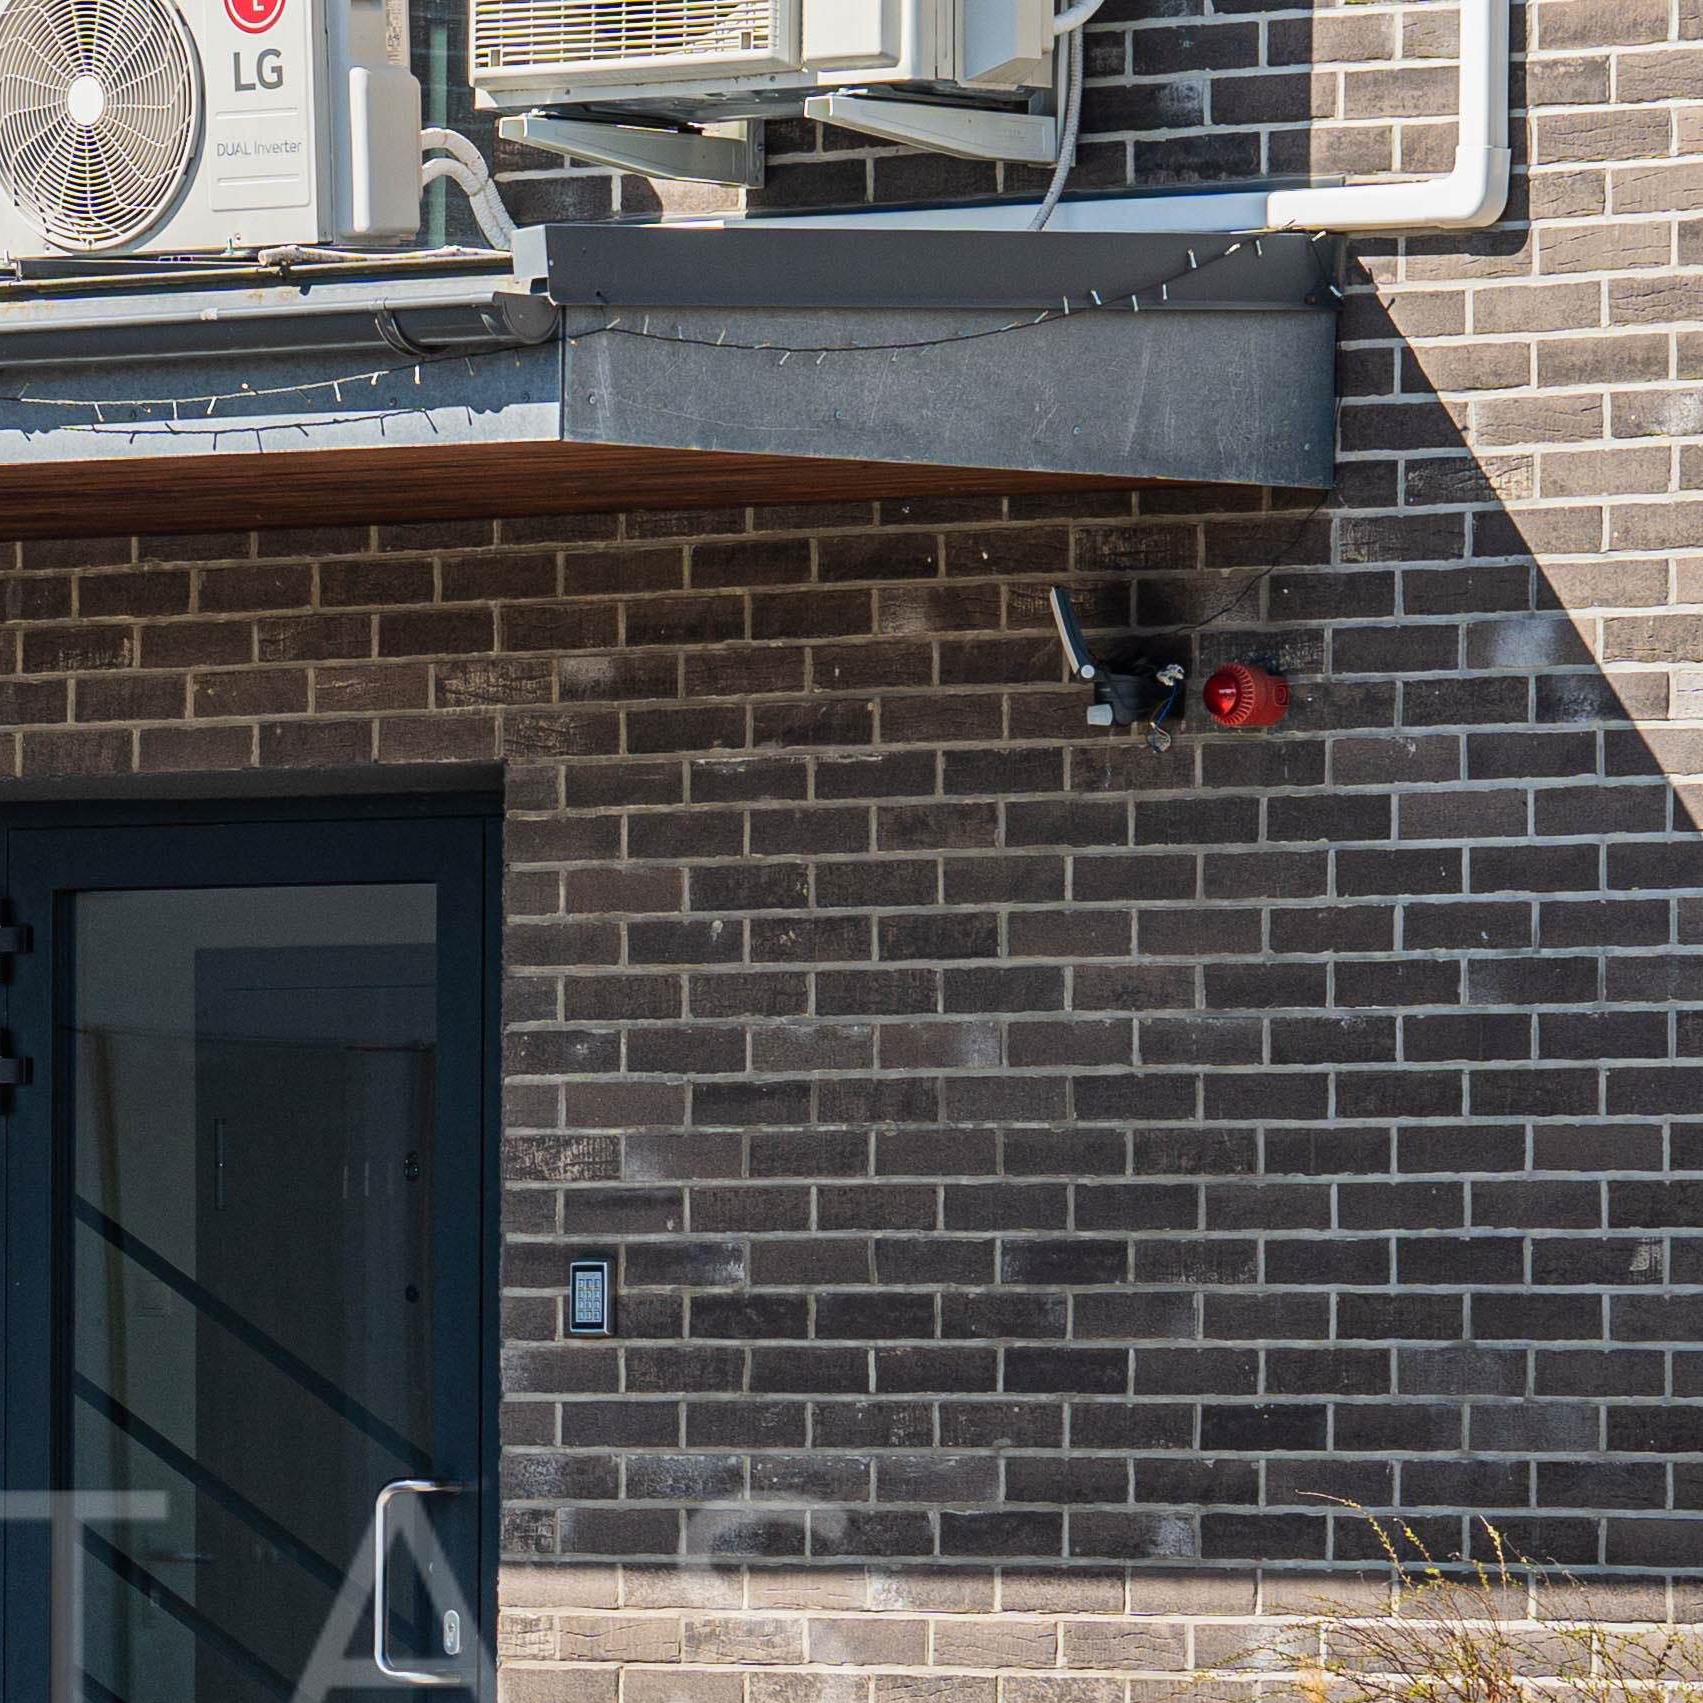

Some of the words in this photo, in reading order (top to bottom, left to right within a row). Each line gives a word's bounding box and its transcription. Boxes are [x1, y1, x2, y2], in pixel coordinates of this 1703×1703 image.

[233, 48, 284, 92] LG
[216, 141, 252, 157] DUAL
[254, 140, 302, 155] Inverter
